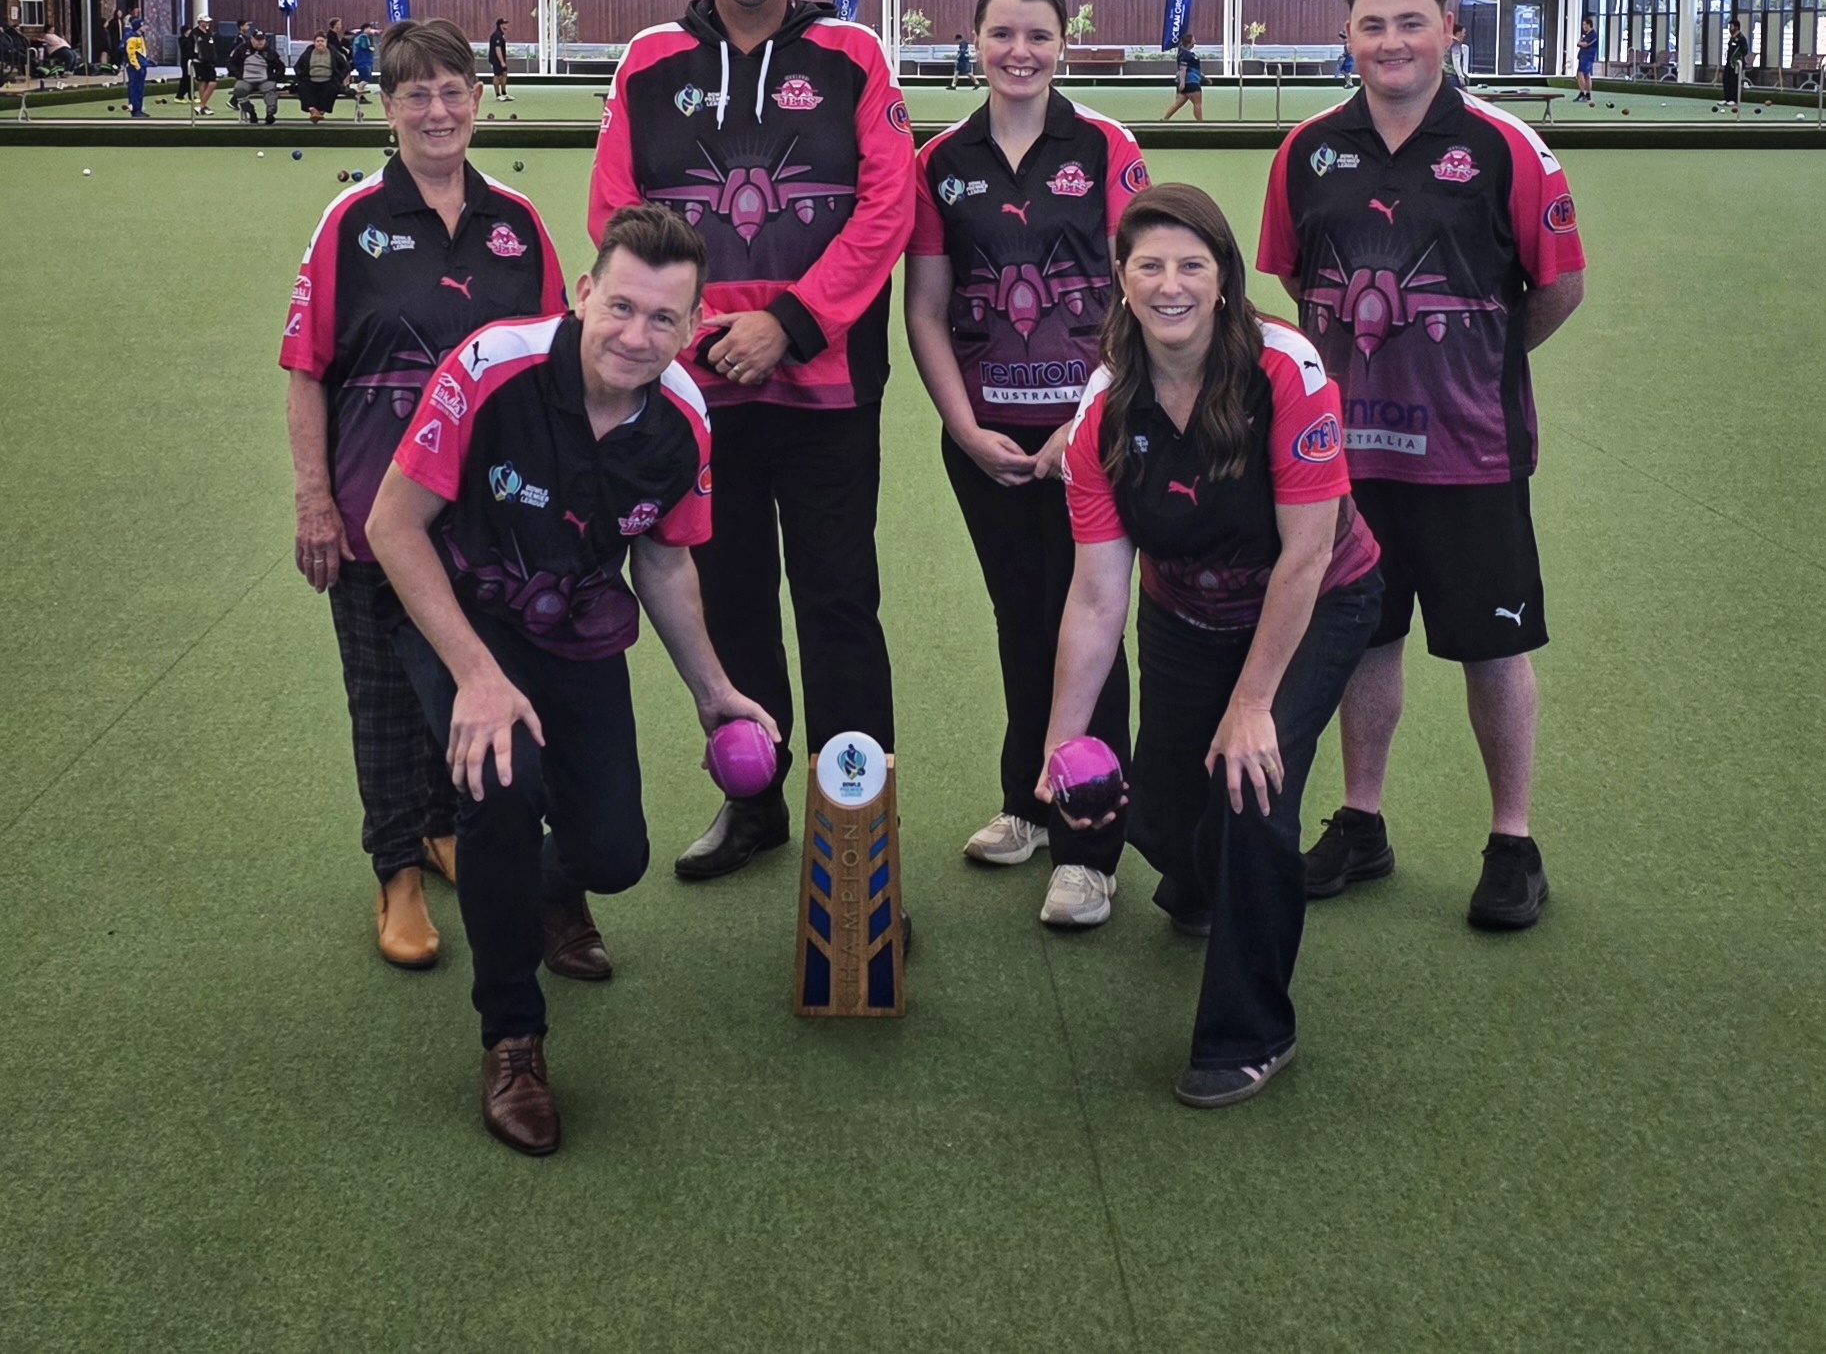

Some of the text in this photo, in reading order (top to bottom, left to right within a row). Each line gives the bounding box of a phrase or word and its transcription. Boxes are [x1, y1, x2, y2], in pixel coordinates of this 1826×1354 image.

[1171, 15, 1181, 44] OCEAN
[781, 95, 816, 107] JETS
[1436, 166, 1472, 180] JETS
[1055, 181, 1088, 194] JETS
[991, 389, 1080, 401] AUSTRALIA
[1345, 399, 1429, 431] nron
[1346, 433, 1416, 450] STRALIA
[840, 824, 861, 1008] CHAMPION
